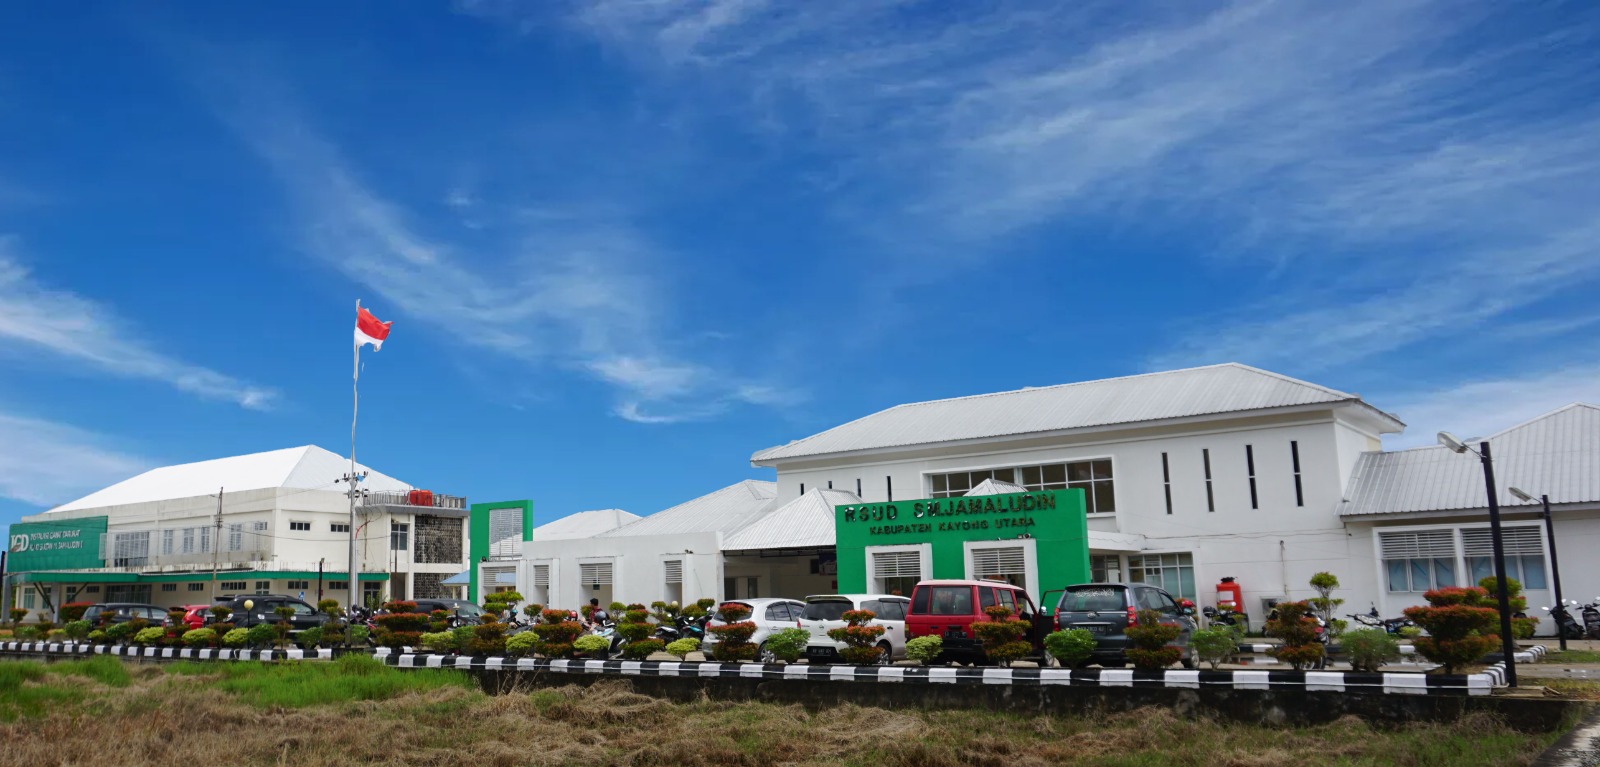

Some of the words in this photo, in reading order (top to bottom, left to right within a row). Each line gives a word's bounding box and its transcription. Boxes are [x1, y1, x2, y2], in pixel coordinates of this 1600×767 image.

[845, 505, 897, 522] RSUD
[870, 524, 932, 535] KABUPATEN
[938, 520, 988, 531] KAYONG
[995, 517, 1035, 528] UTARA
[11, 534, 29, 552] IGD
